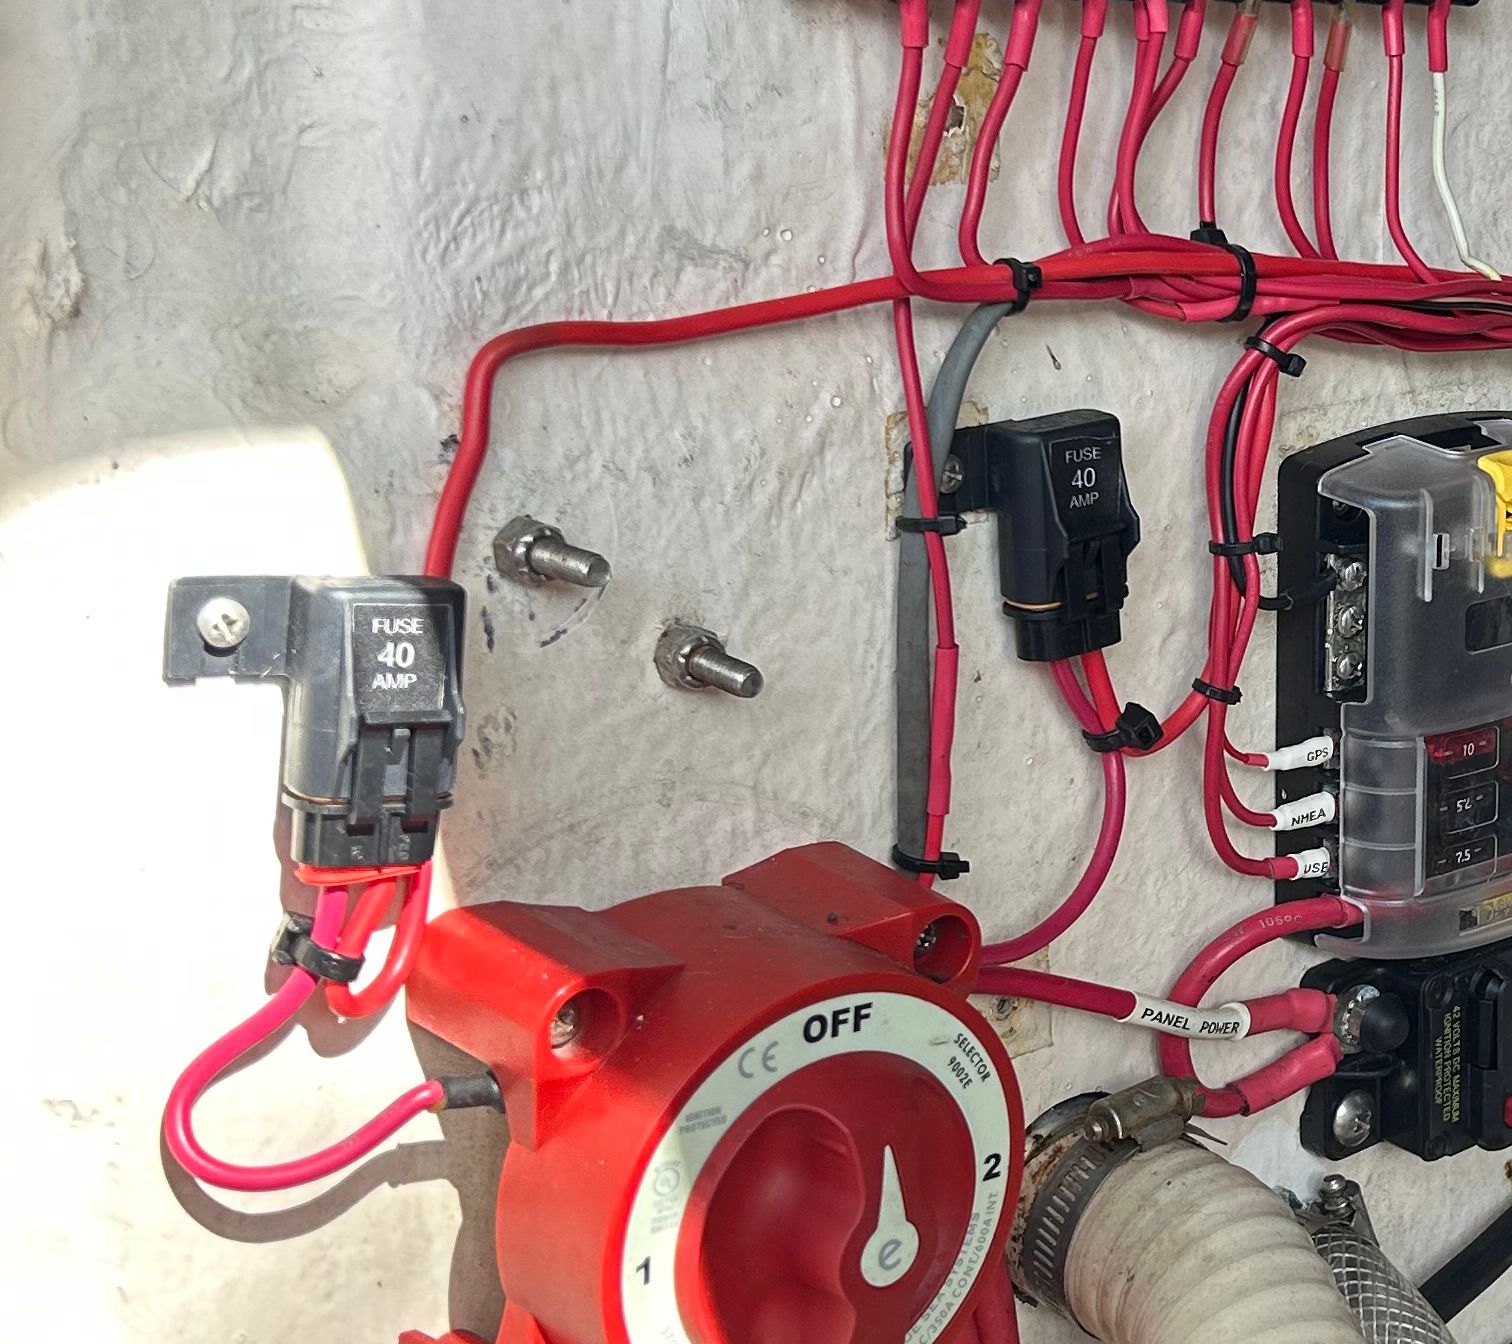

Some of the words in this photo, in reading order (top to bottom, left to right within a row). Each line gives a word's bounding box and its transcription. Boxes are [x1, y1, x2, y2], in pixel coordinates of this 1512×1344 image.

[1065, 446, 1102, 464] FUSE
[1071, 467, 1096, 489] 40
[1069, 491, 1100, 509] AMP
[371, 617, 424, 634] FUSE
[377, 641, 416, 669] 40
[371, 672, 418, 690] AMP
[1306, 747, 1329, 762] GPS
[1462, 742, 1475, 757] 10
[1290, 807, 1327, 827] NMEA
[802, 1001, 874, 1044] OFF
[1140, 1007, 1191, 1031] PANEL
[1199, 1020, 1240, 1035] POWER
[1452, 1005, 1461, 1017] 42
[1443, 1012, 1452, 1059] IGNITION
[1452, 1020, 1461, 1055] VOLTS
[953, 1032, 991, 1083] SELECTOR
[1434, 1036, 1443, 1104] WATERPROOF
[1452, 1056, 1461, 1072] DC
[946, 1055, 973, 1090] 9002E
[1442, 1060, 1451, 1121] PROTECTED
[981, 1153, 1001, 1182] 2
[635, 1255, 651, 1286] 1
